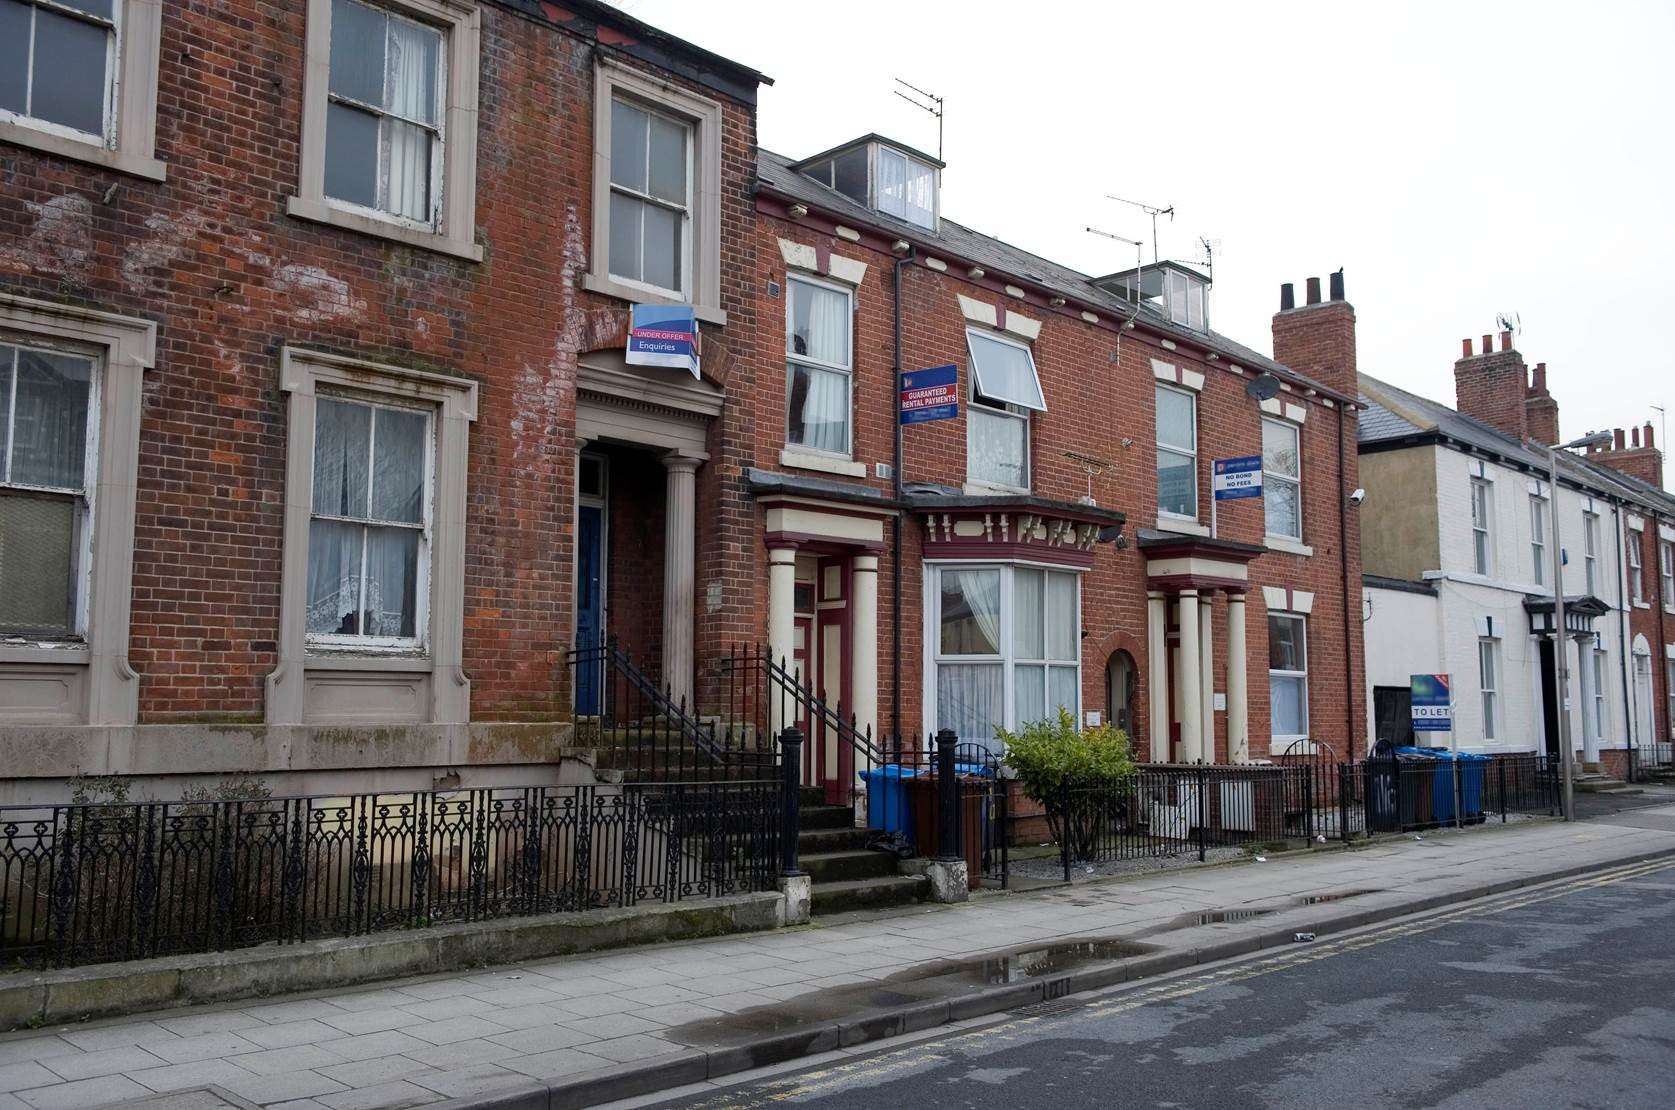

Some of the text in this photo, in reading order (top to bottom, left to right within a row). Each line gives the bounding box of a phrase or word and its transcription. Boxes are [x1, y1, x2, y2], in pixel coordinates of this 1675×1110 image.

[637, 331, 660, 340] UNDER
[640, 341, 676, 351] Enquiries
[908, 388, 947, 400] GUARANTEED
[902, 394, 956, 408] RENTAL PAYMENTS
